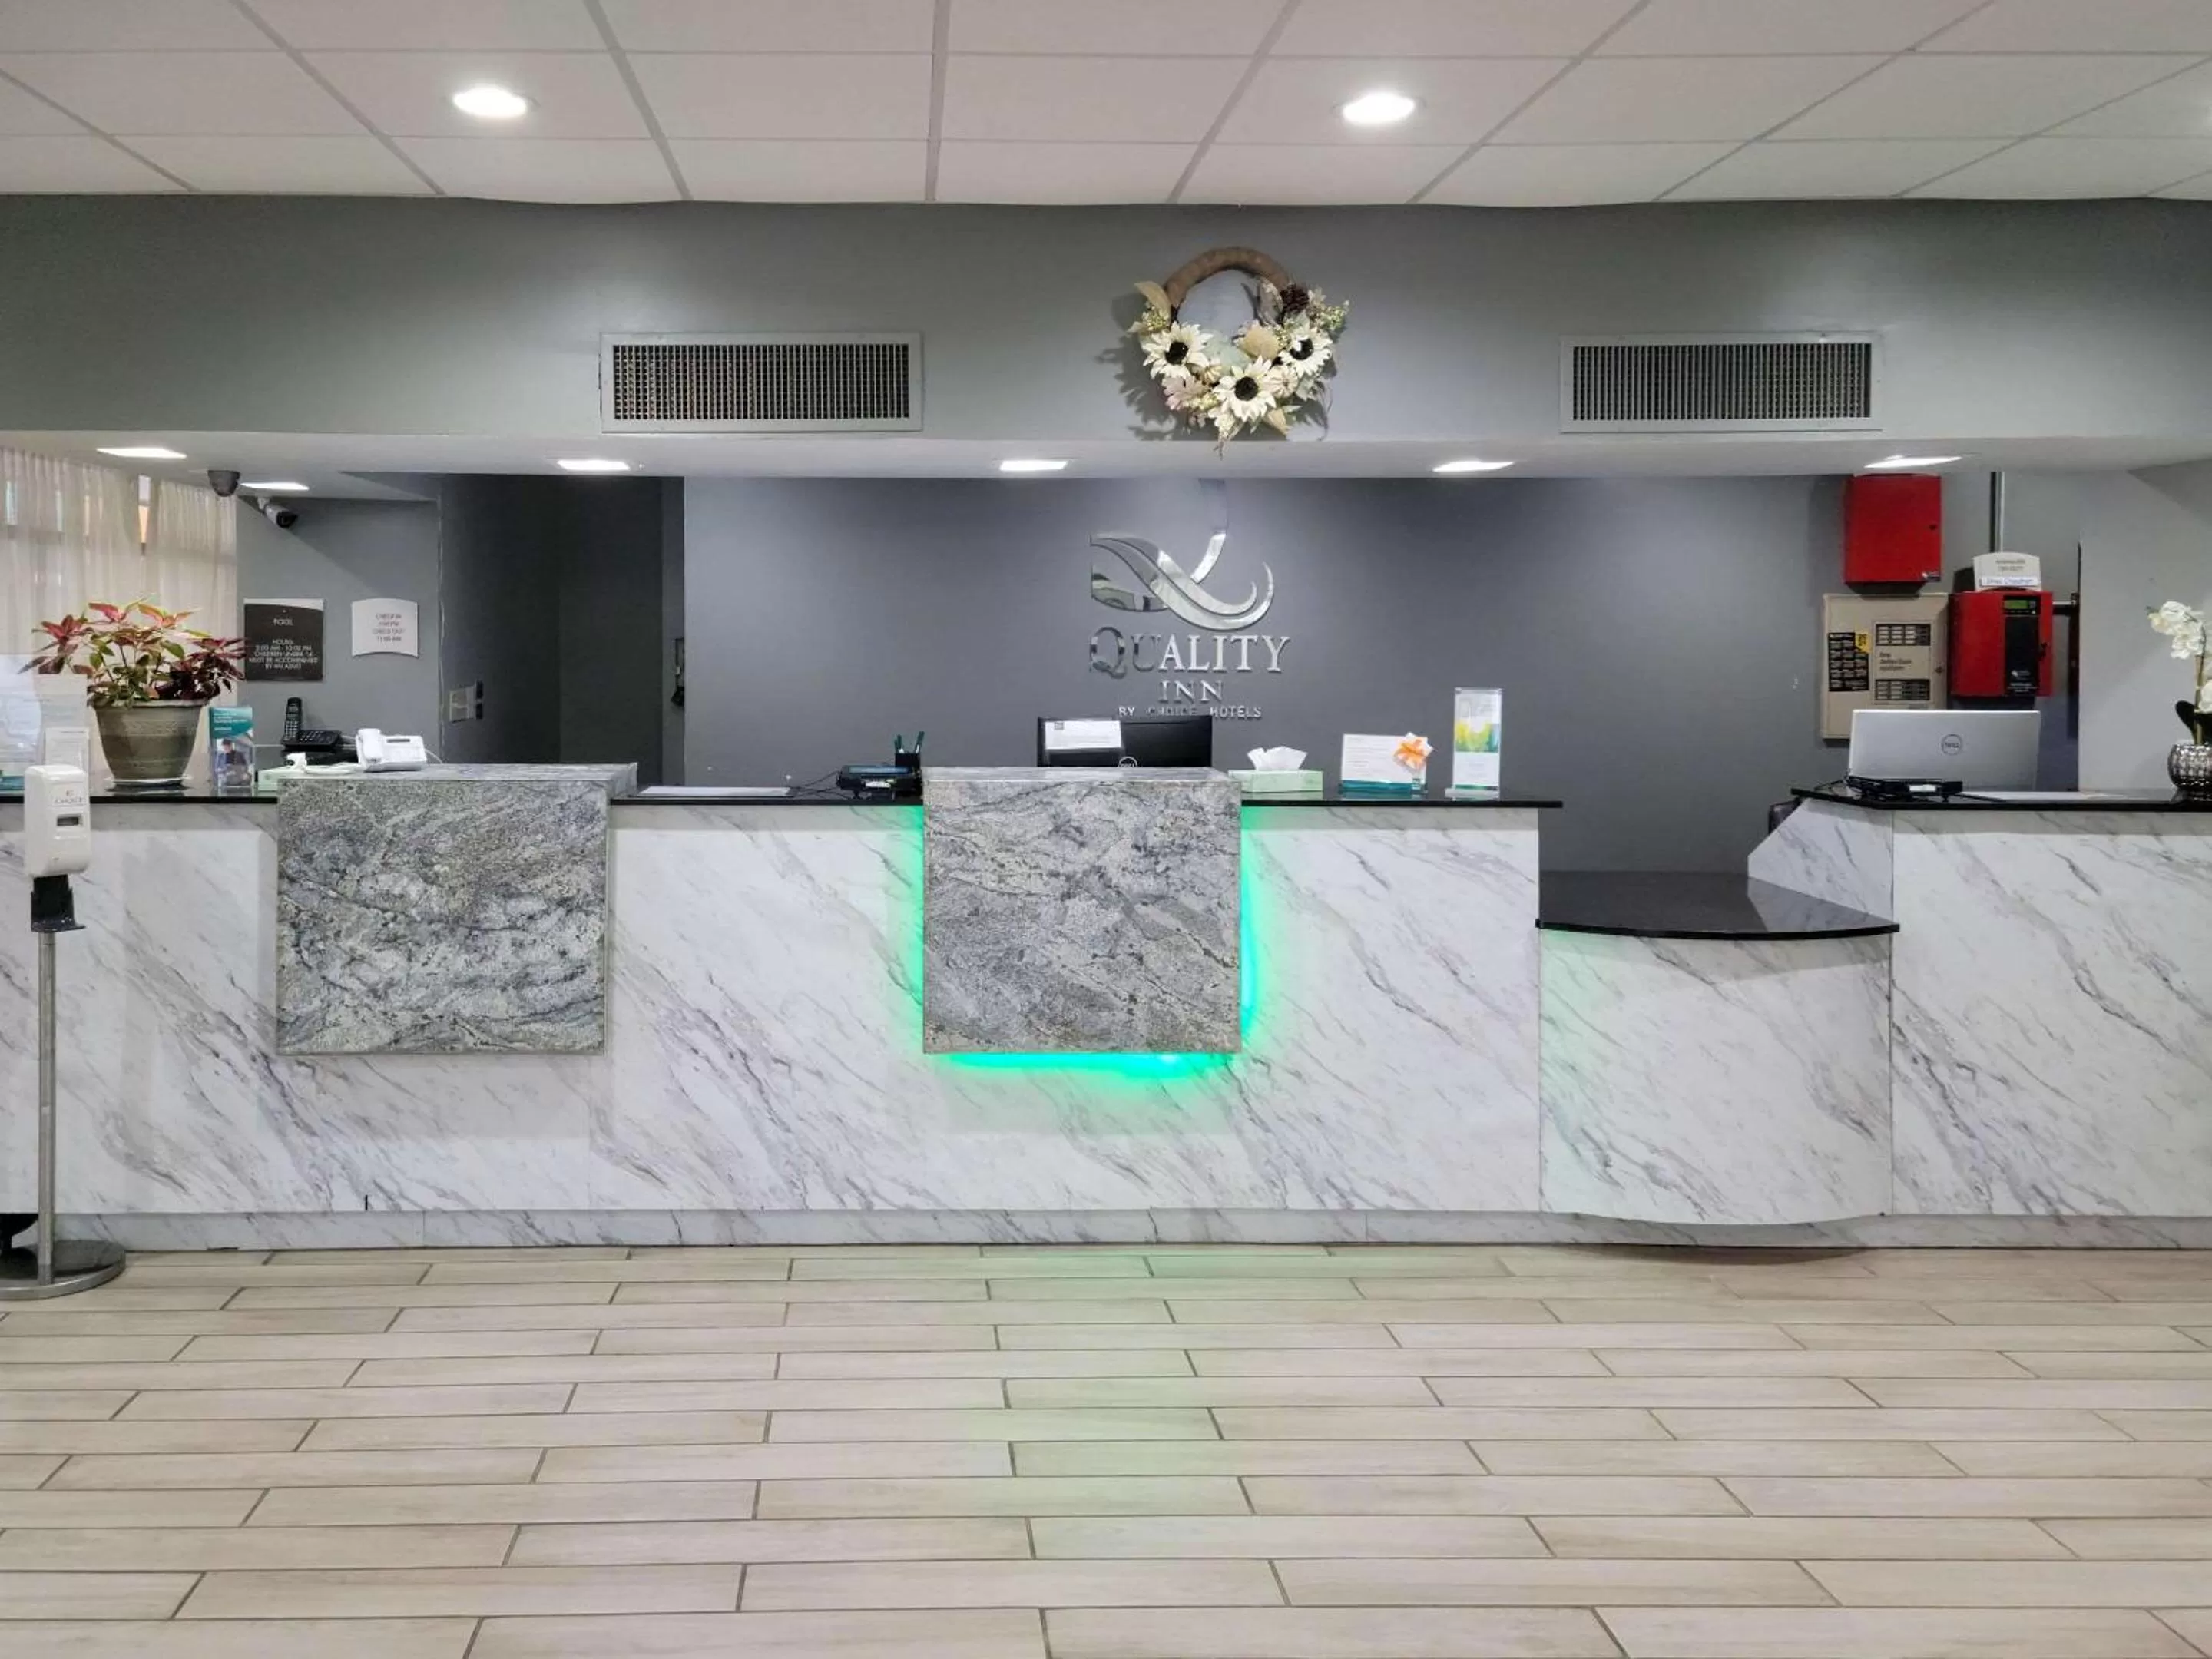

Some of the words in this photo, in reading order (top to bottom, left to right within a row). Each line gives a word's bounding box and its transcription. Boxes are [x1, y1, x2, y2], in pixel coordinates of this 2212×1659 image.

[273, 618, 294, 627] POOL
[1088, 625, 1291, 679] QUALITY
[1157, 680, 1224, 704] INN
[1118, 705, 1136, 717] BY
[1209, 705, 1262, 719] HOTELS
